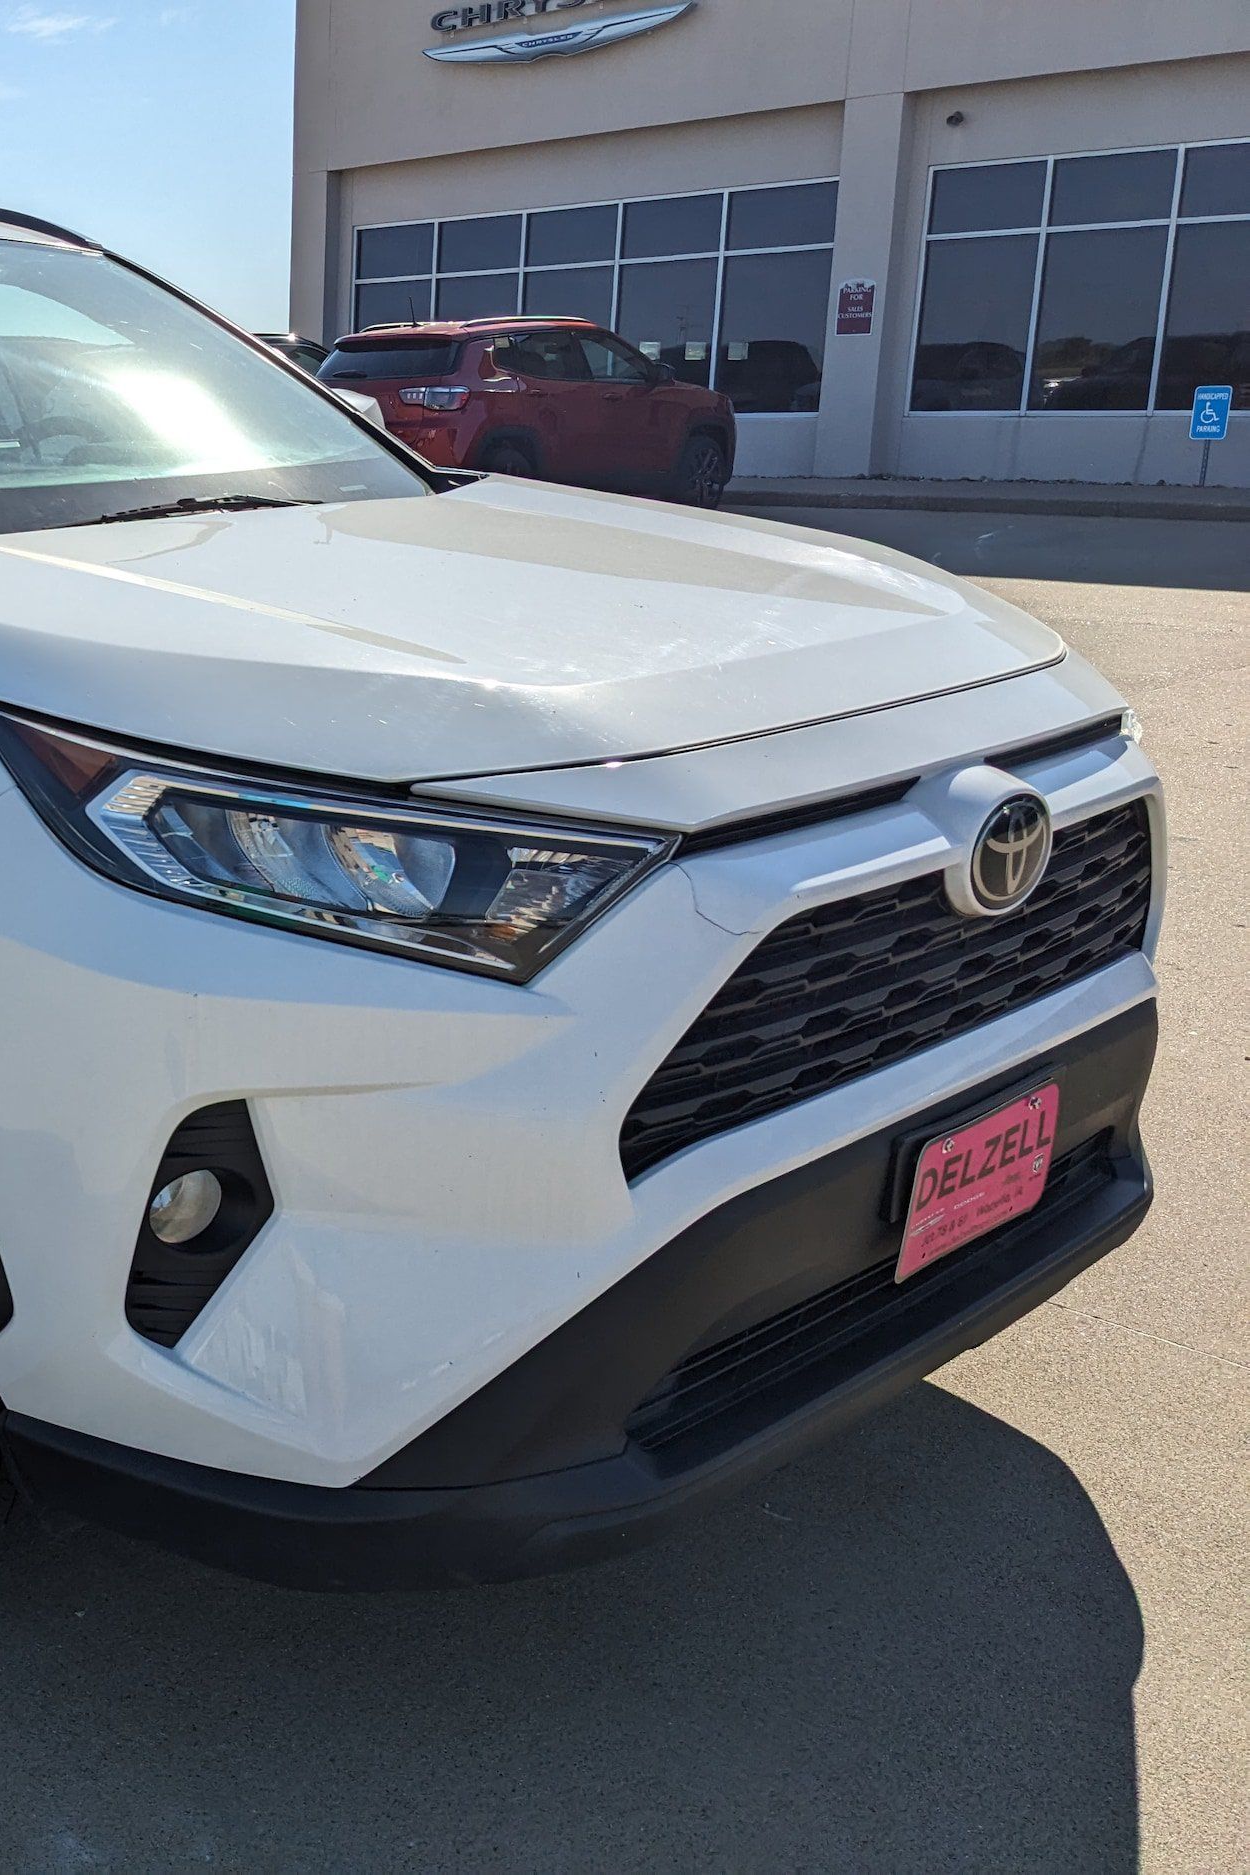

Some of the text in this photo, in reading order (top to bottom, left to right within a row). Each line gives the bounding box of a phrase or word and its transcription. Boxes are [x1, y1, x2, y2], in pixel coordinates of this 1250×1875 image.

[842, 286, 872, 294] PARKING
[1197, 392, 1229, 400] HANDICAPPED
[1196, 425, 1221, 433] PARKING
[915, 1110, 1051, 1213] DELZELL
